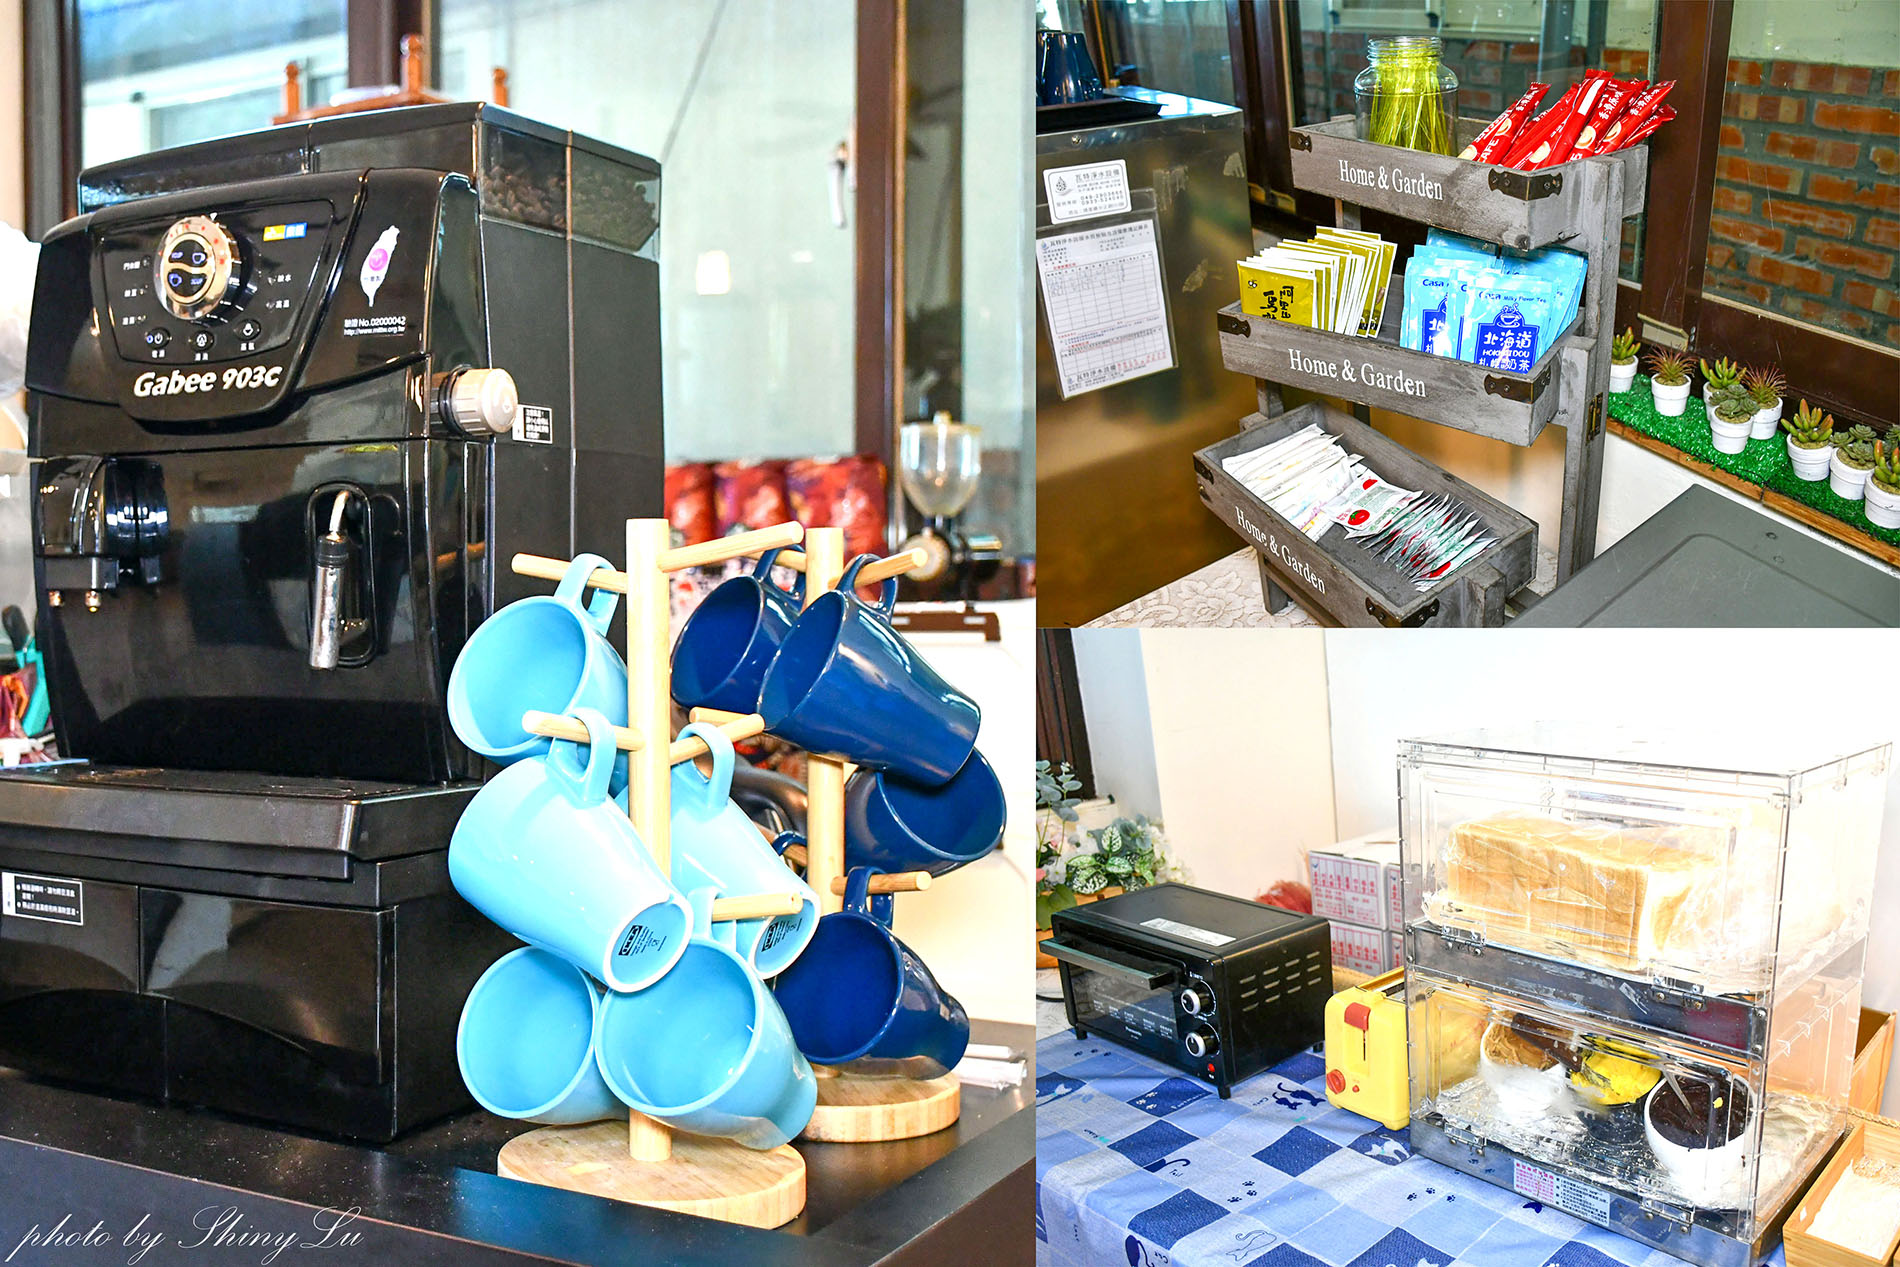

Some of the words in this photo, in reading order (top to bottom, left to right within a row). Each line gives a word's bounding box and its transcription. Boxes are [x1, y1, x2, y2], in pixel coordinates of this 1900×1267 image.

[1338, 159, 1375, 187] Home
[1378, 166, 1389, 190] &
[1392, 168, 1443, 200] Garden
[1422, 278, 1444, 287] Casa
[1483, 329, 1532, 349] 北海道
[133, 369, 217, 397] Gabee
[1288, 348, 1338, 378] Home
[1341, 359, 1357, 382] &
[1360, 363, 1426, 397] Garden
[1235, 506, 1267, 544] Home
[1269, 535, 1280, 558] &
[1281, 545, 1326, 594] Garden
[619, 925, 642, 955] IKEA
